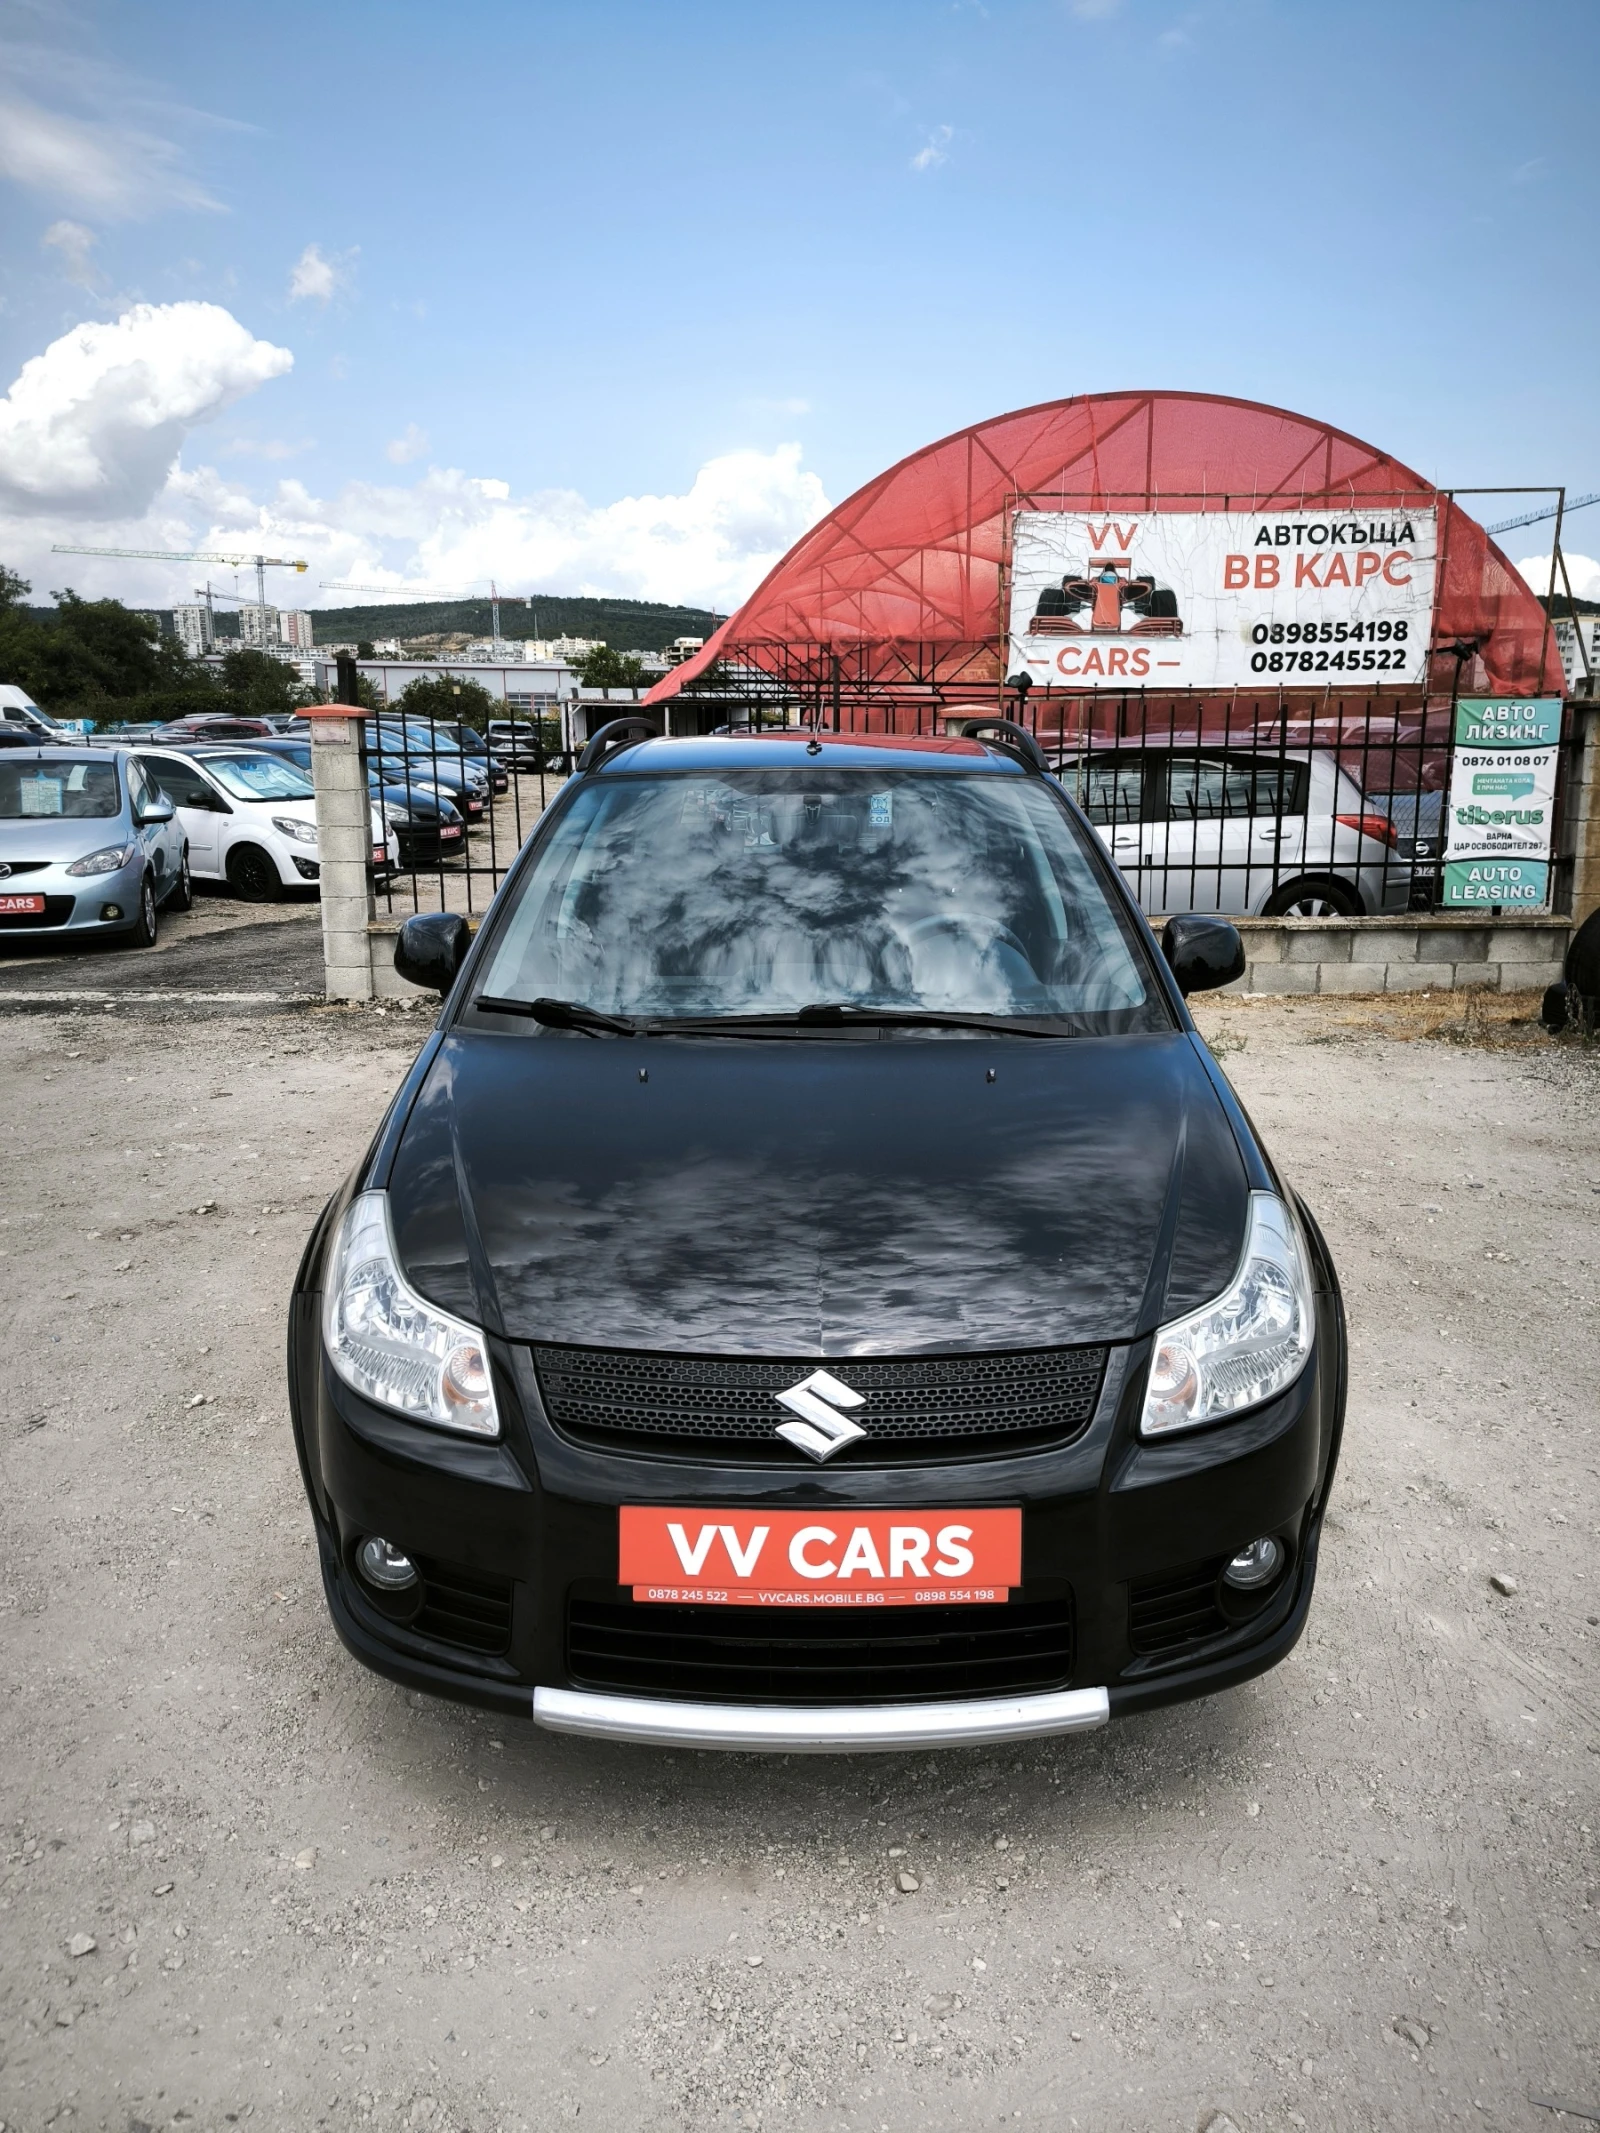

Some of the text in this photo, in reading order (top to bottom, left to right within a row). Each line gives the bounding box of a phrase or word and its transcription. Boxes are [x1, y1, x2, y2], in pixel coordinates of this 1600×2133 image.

[1086, 523, 1139, 551] VV
[1254, 521, 1416, 547] АВТОКЪЩА
[1224, 550, 1414, 589] ВВ КАРС
[1251, 620, 1409, 645] 0898554198
[1056, 647, 1151, 676] CARS
[1250, 648, 1407, 673] 0878245522
[1481, 705, 1536, 721] АВТО
[1465, 724, 1550, 740] ЛИЗИНГ
[1462, 756, 1549, 767] 0876 01 08 07
[1455, 804, 1544, 825] tiberus
[1486, 832, 1513, 840] ВАРНА
[1453, 842, 1471, 851] ЦАР
[1471, 842, 1528, 850] ОСВОБОДИТЕЛ
[1468, 867, 1522, 882] AUTO
[1451, 885, 1537, 900] LEASING
[666, 1523, 974, 1579] VV CARS
[647, 1588, 995, 1604] 0878 245 522 VVCARS.MOBILE.BG 0898 554 198
